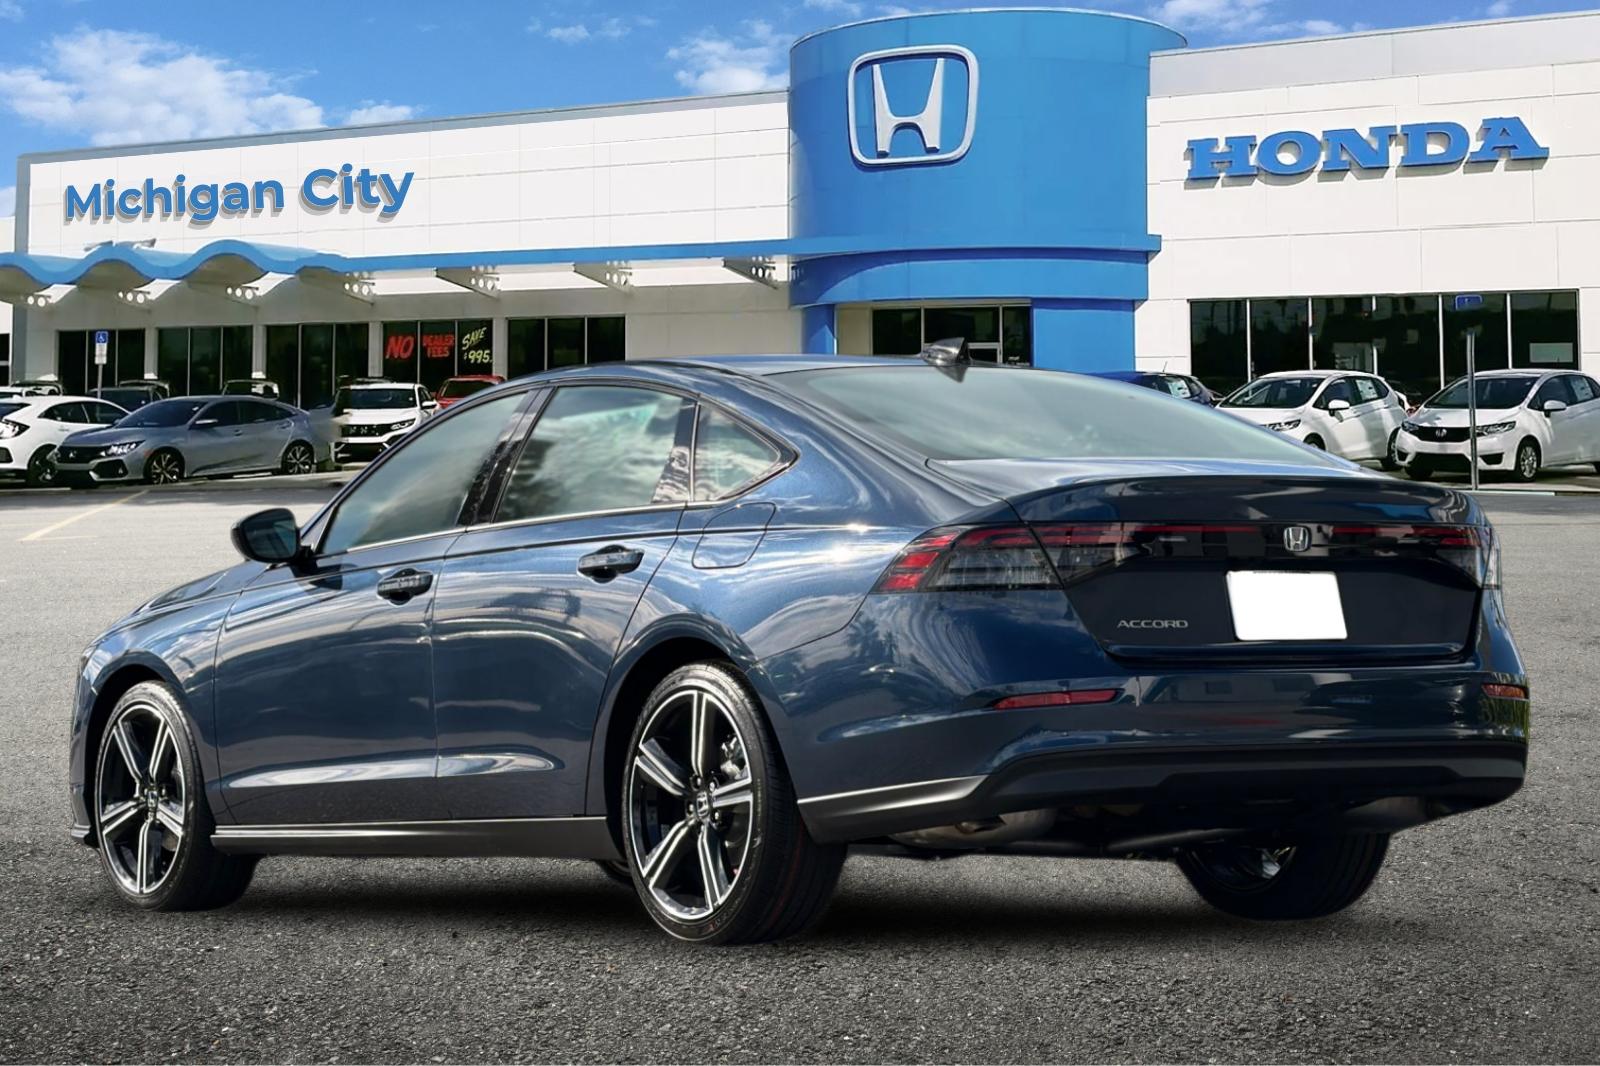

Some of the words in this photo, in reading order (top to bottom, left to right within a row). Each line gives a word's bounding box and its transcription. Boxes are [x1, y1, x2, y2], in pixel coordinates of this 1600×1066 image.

[1185, 116, 1550, 182] HONDA
[65, 174, 285, 222] Michigan
[302, 163, 415, 215] City
[386, 335, 415, 359] NO
[461, 327, 488, 350] SAVE
[1116, 619, 1190, 629] ACCORD
